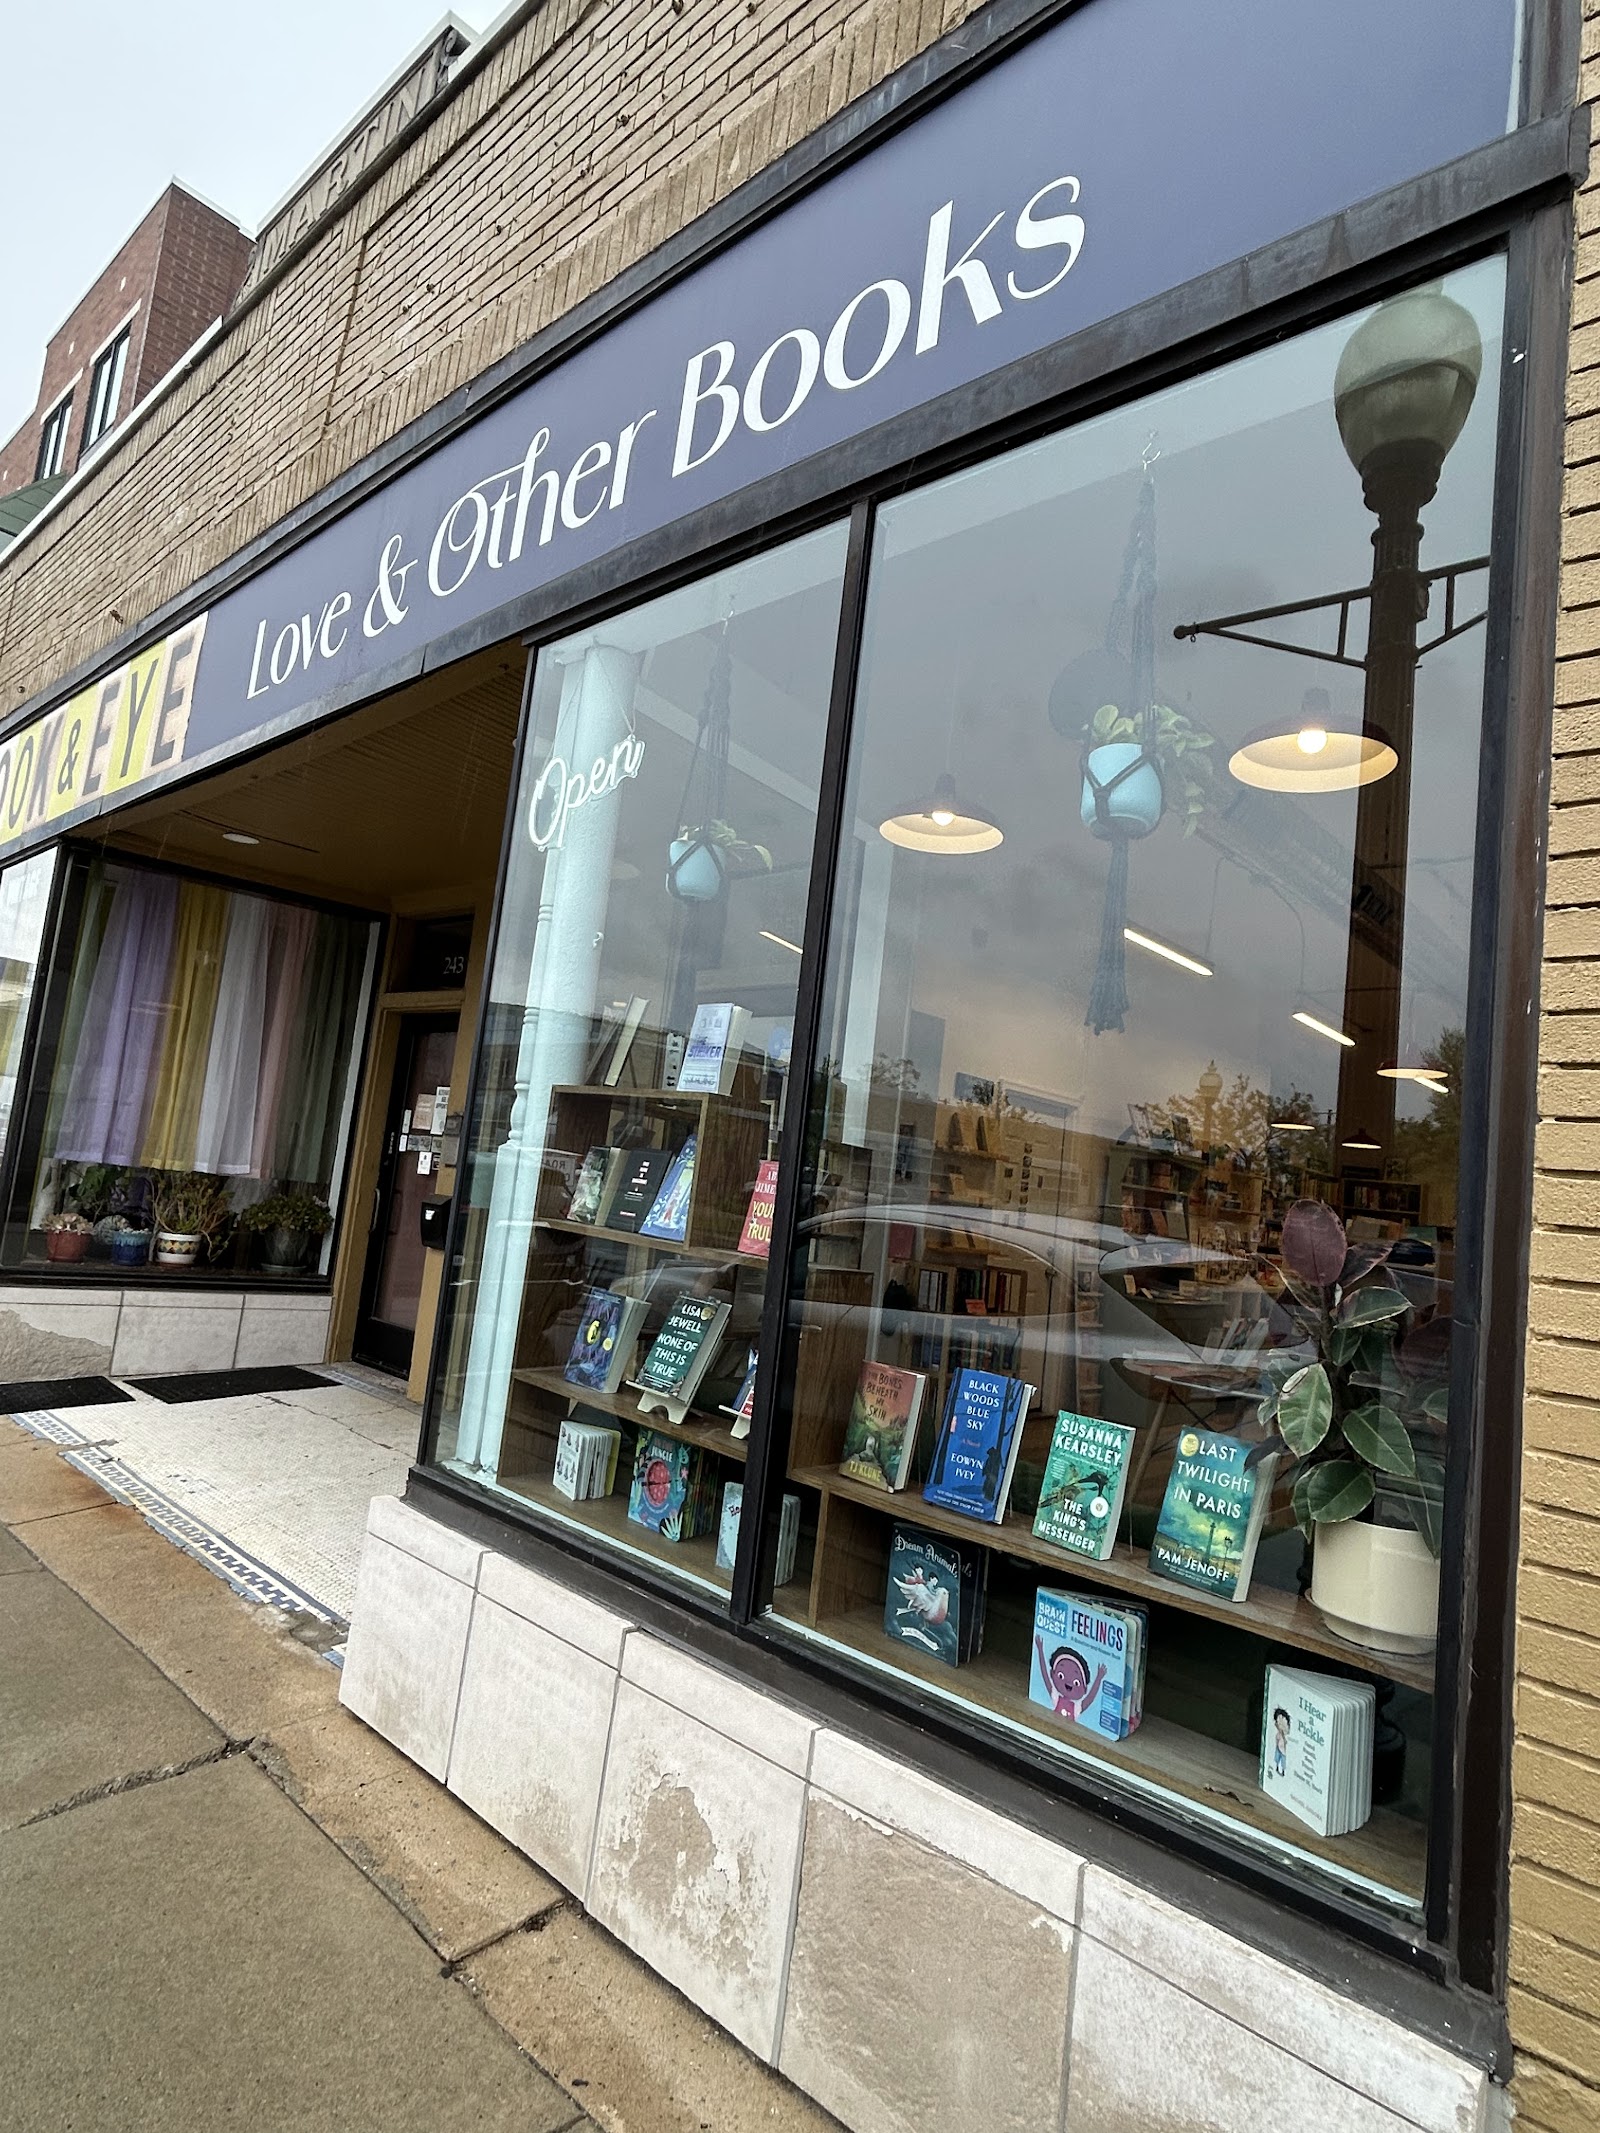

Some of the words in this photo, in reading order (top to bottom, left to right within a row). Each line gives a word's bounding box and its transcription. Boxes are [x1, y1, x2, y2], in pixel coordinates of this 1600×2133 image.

[257, 65, 426, 276] MARTIN
[247, 592, 352, 699] Love
[362, 534, 418, 638] &
[427, 409, 658, 597] Other
[672, 175, 1086, 479] Books
[58, 719, 82, 795] &
[82, 632, 197, 797] EYE
[528, 740, 643, 848] Open
[443, 956, 465, 975] 243
[681, 1303, 701, 1318] LISA
[668, 1315, 702, 1333] JEWELL
[657, 1333, 683, 1350] NONE
[683, 1341, 699, 1353] OF
[655, 1347, 677, 1363] THIS
[675, 1353, 687, 1366] IS
[652, 1361, 677, 1378] TRUE
[968, 1379, 1000, 1395] BLACK
[963, 1391, 1000, 1408] WOODS
[868, 1405, 887, 1421] SKIN
[966, 1405, 990, 1419] BLUE
[966, 1418, 985, 1431] SKY
[1060, 1418, 1122, 1450] SUSANNA
[650, 1445, 673, 1463] JUNGLE
[1055, 1434, 1122, 1466] KEARSLEY
[1199, 1440, 1238, 1463] LAST
[849, 1460, 859, 1473] TJ
[859, 1464, 882, 1482] KLUNE
[950, 1453, 984, 1470] EOWYN
[955, 1468, 976, 1481] IVEY
[1177, 1461, 1250, 1494] TWILIGHT
[1063, 1498, 1083, 1516] THE
[1173, 1486, 1191, 1503] IN
[1196, 1492, 1241, 1519] PARIS
[1053, 1510, 1087, 1531] KING'S
[1037, 1520, 1095, 1552] MESSENGER
[895, 1534, 924, 1552] Dream
[925, 1543, 958, 1578] Animals
[1157, 1549, 1181, 1566] PAM
[1184, 1556, 1230, 1582] JENOFF
[1038, 1602, 1066, 1624] BRAIN
[1037, 1614, 1066, 1637] QUEST
[1071, 1610, 1124, 1652] FEELINGS
[1304, 1700, 1327, 1722] Hear
[1309, 1715, 1315, 1726] a
[1298, 1719, 1325, 1747] Pickle
